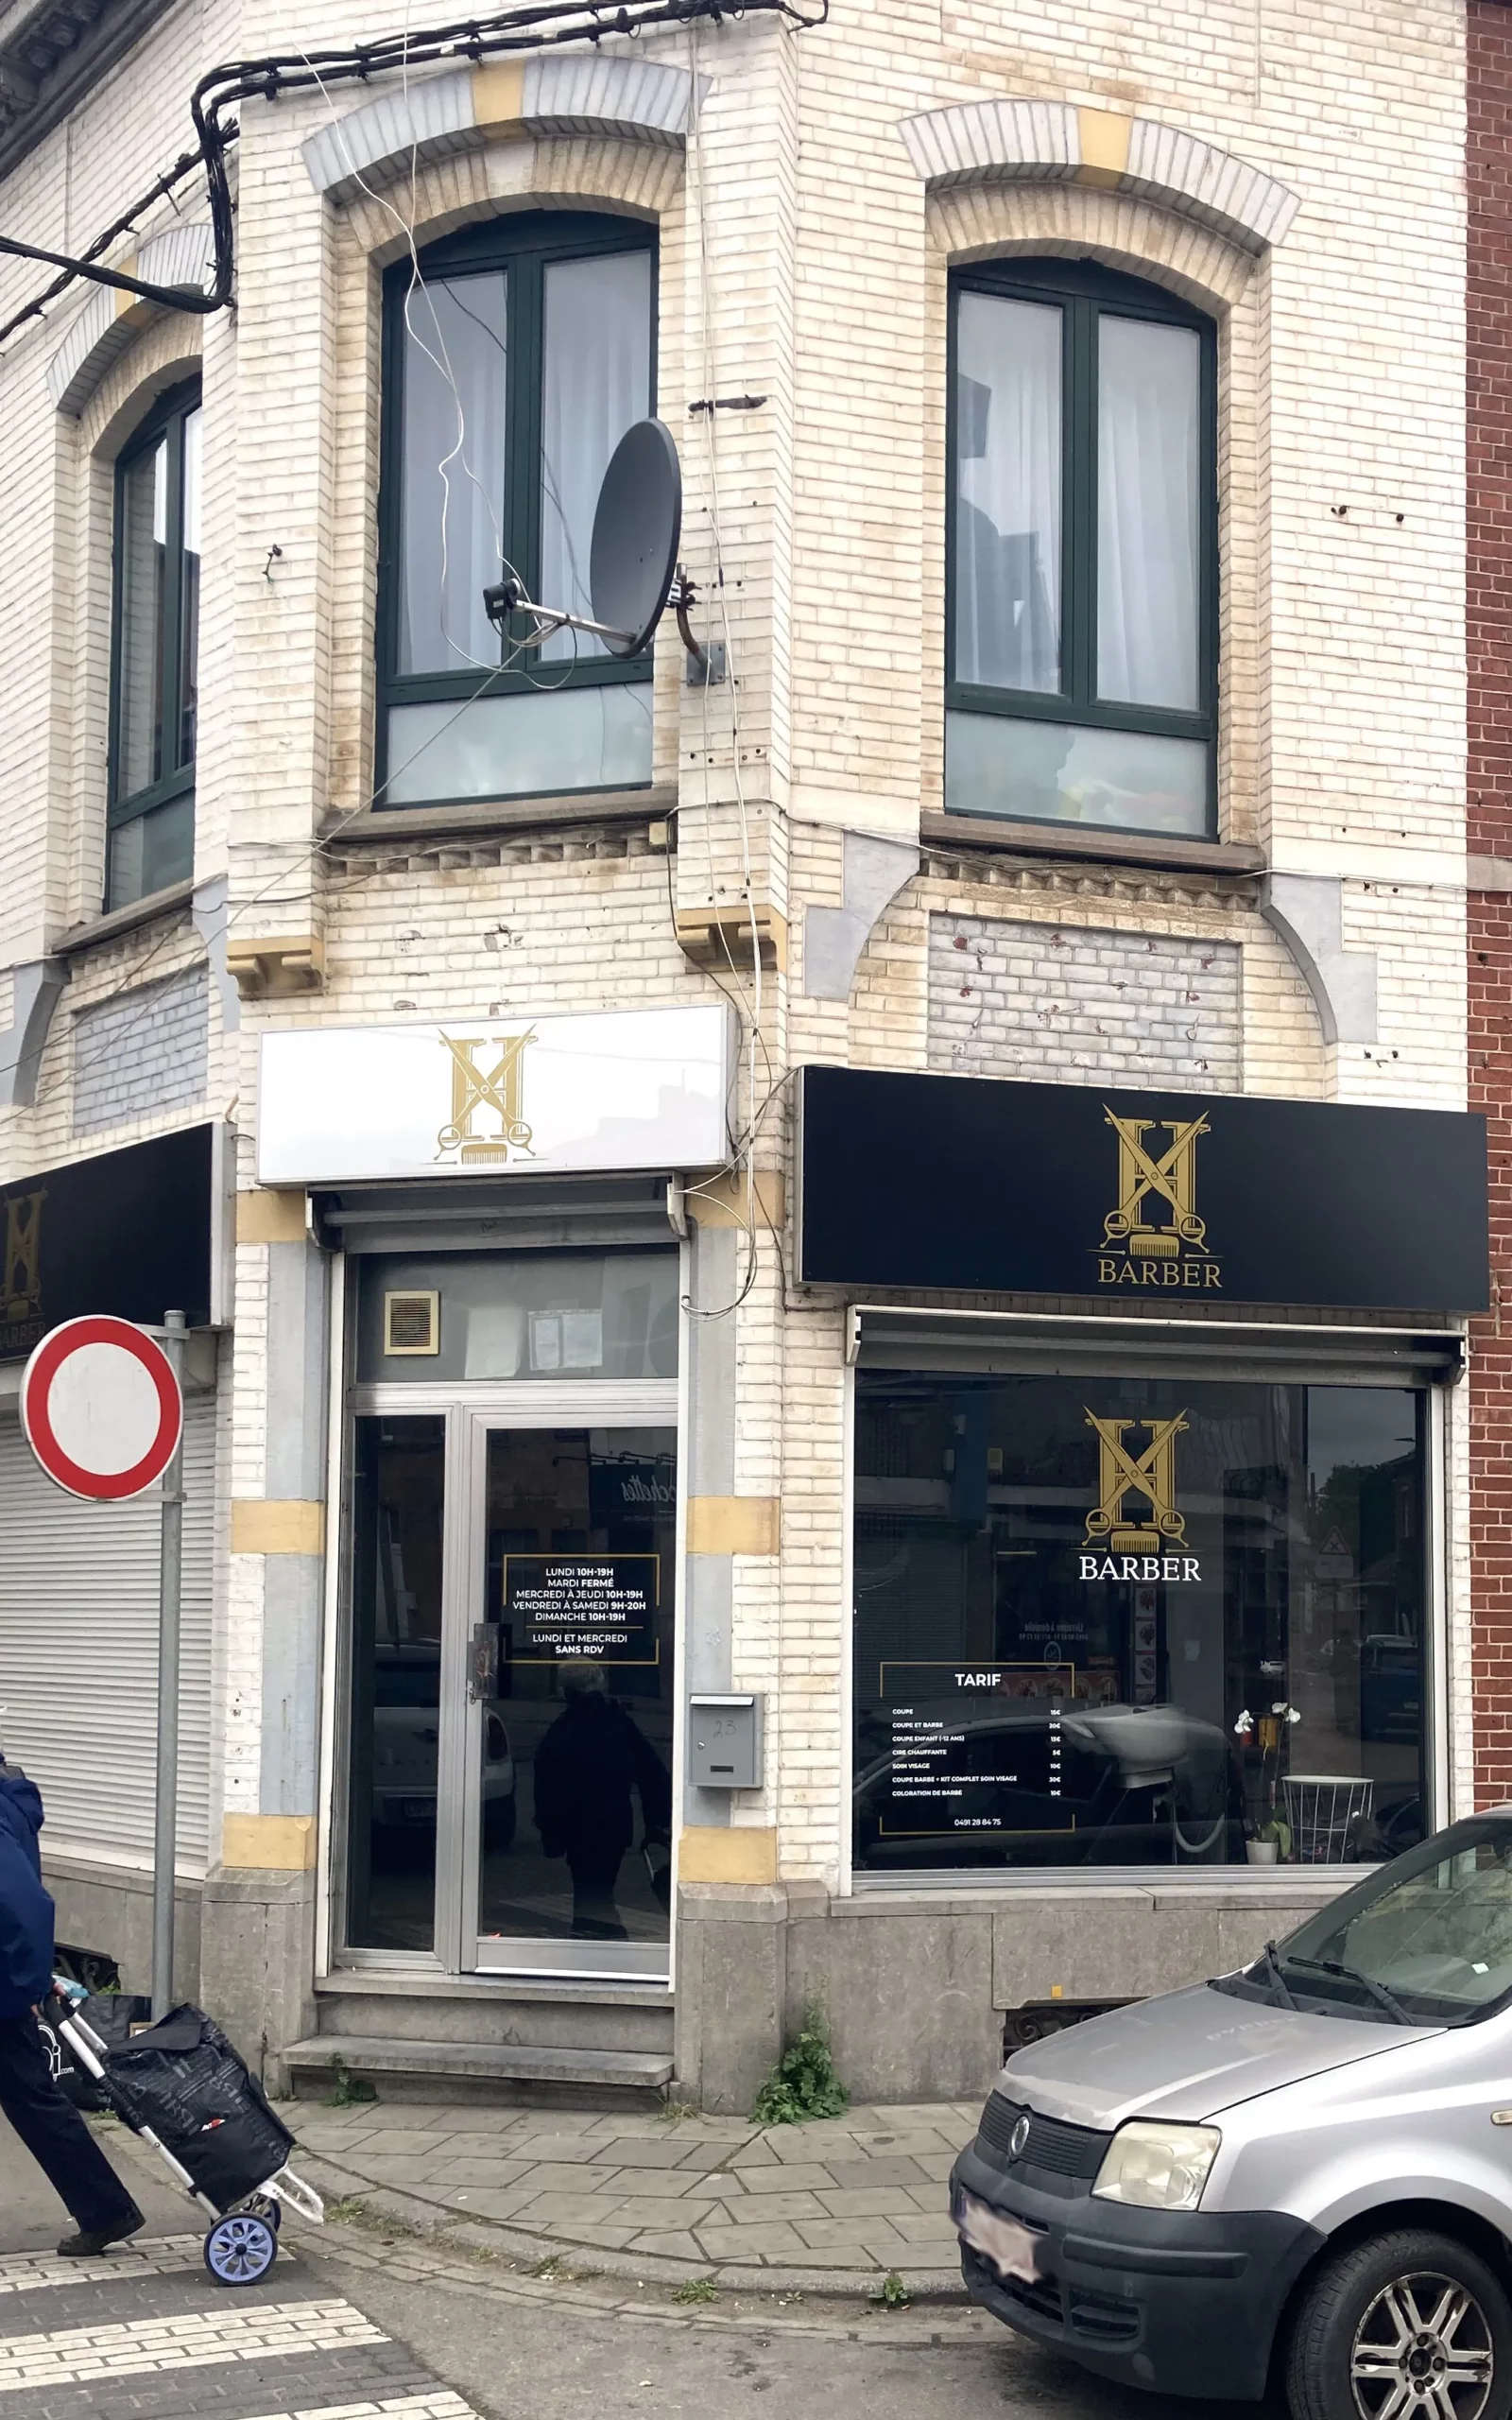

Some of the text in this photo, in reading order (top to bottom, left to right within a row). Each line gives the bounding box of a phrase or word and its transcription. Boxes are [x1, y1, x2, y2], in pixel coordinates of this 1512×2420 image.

[1098, 1258, 1223, 1288] BARBER
[0, 1321, 45, 1350] ARBER
[1079, 1555, 1201, 1582] BARBER
[582, 1578, 613, 1587] FERMÉ
[517, 1590, 565, 1599] MERCREDI
[567, 1588, 574, 1598] À
[563, 1600, 570, 1609] À
[533, 1634, 561, 1643] LUNDI
[577, 1634, 627, 1643] MERCREDI
[954, 1674, 1001, 1685] TARIF
[713, 1720, 737, 1738] 23
